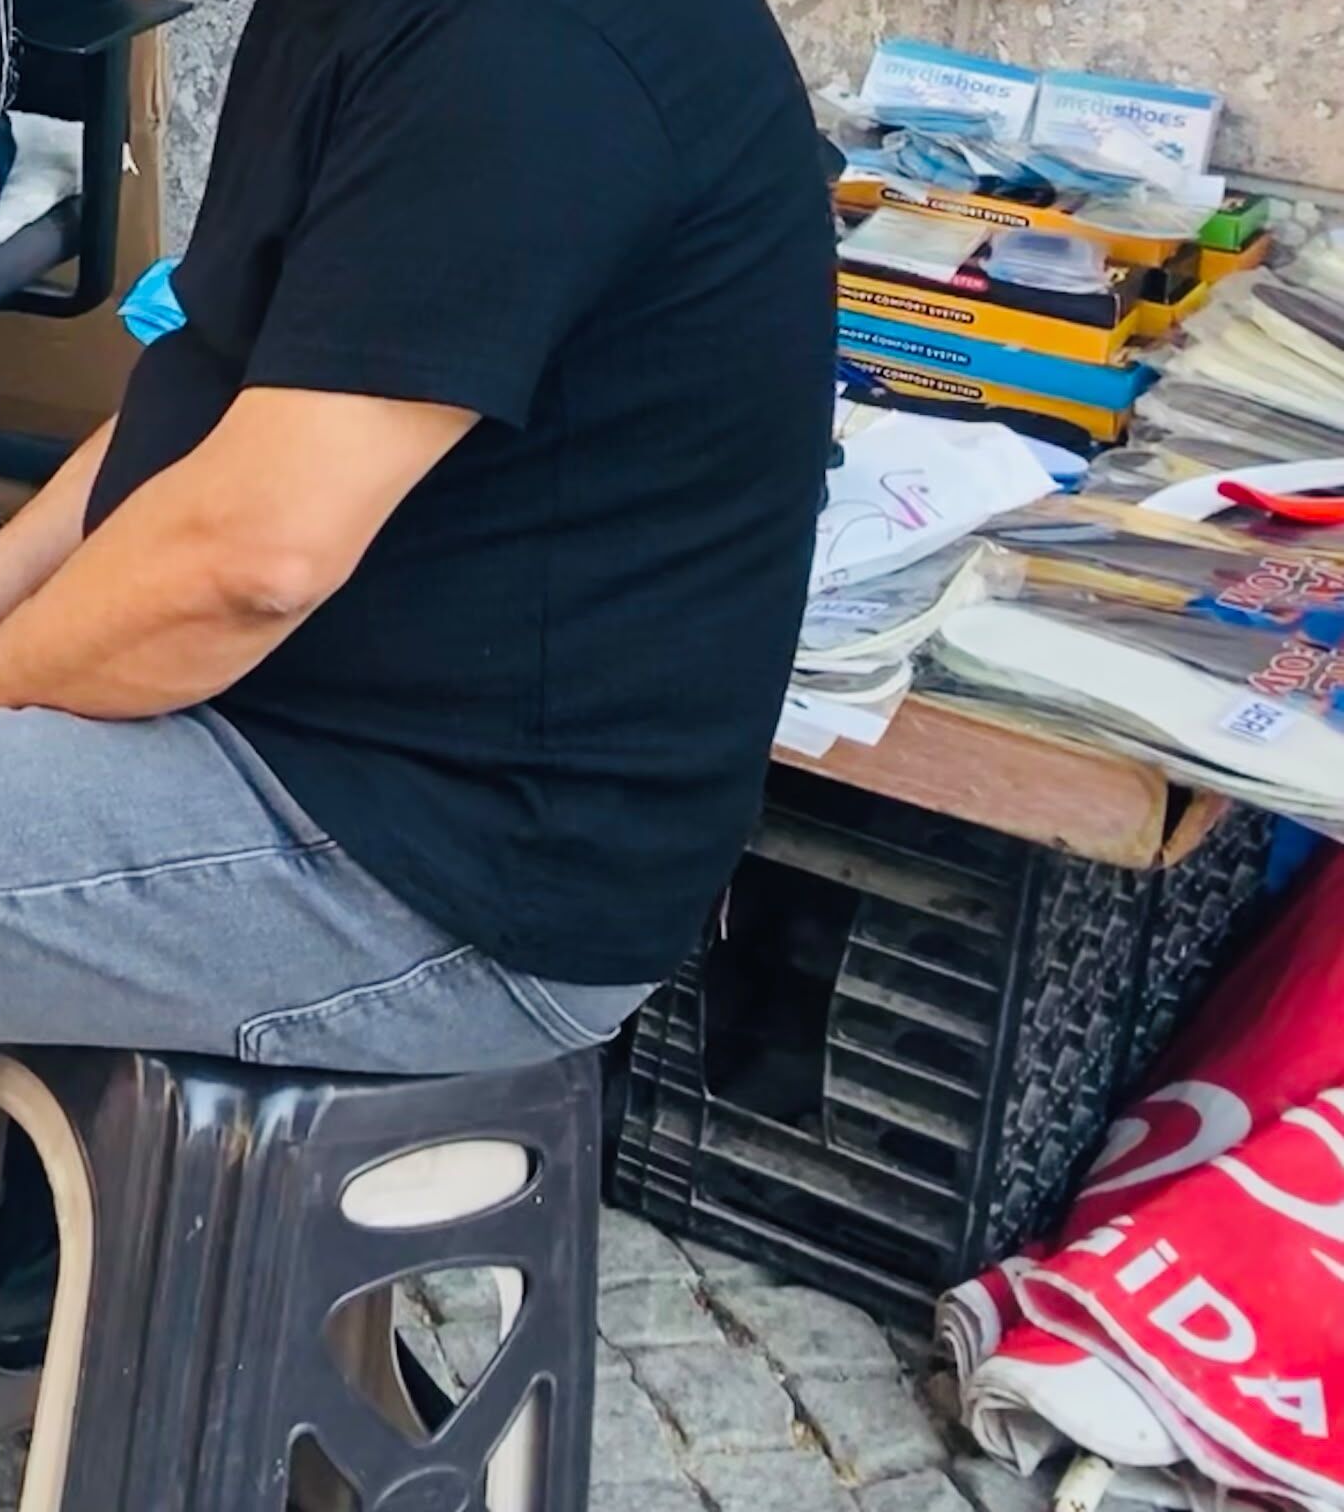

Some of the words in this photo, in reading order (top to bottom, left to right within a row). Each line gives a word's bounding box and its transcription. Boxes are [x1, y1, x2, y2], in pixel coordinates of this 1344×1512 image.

[885, 61, 1011, 98] medishoes
[1056, 94, 1186, 128] medishoes
[874, 294, 928, 314] COMFORT
[928, 306, 971, 322] SYSTEM
[872, 332, 924, 354] COMFORT
[926, 347, 968, 364] SYSTEM
[883, 367, 936, 387] COMFORT
[937, 380, 980, 397] SYSTEM
